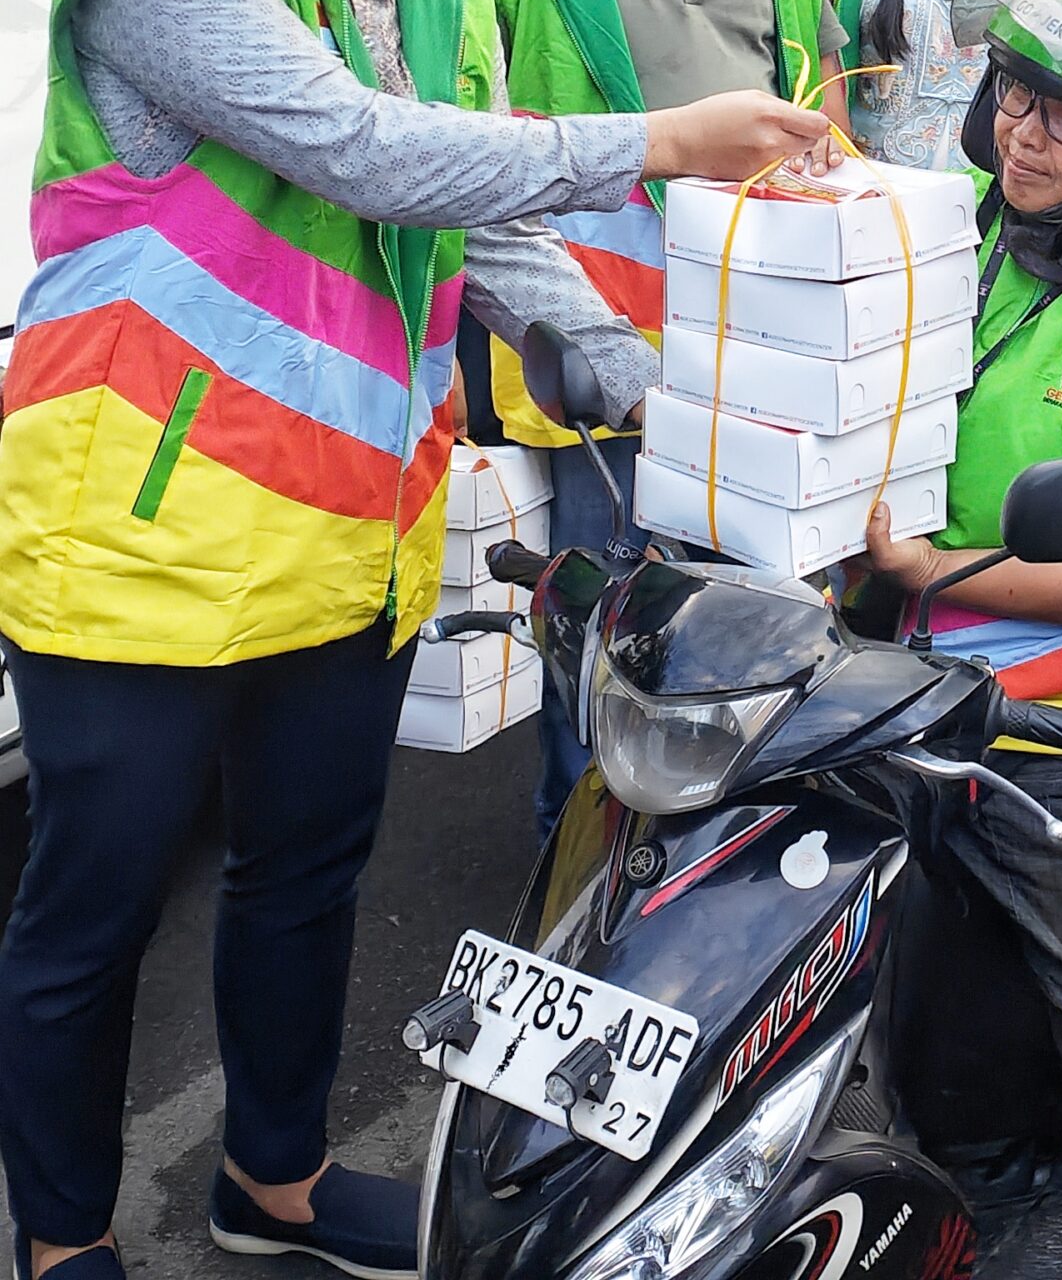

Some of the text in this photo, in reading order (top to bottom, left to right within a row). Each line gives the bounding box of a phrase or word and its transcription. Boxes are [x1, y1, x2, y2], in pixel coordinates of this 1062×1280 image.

[486, 959, 592, 1041] 2785
[609, 1007, 693, 1079] ADF
[602, 1101, 652, 1144] 27
[857, 1202, 914, 1274] YAMAHA
